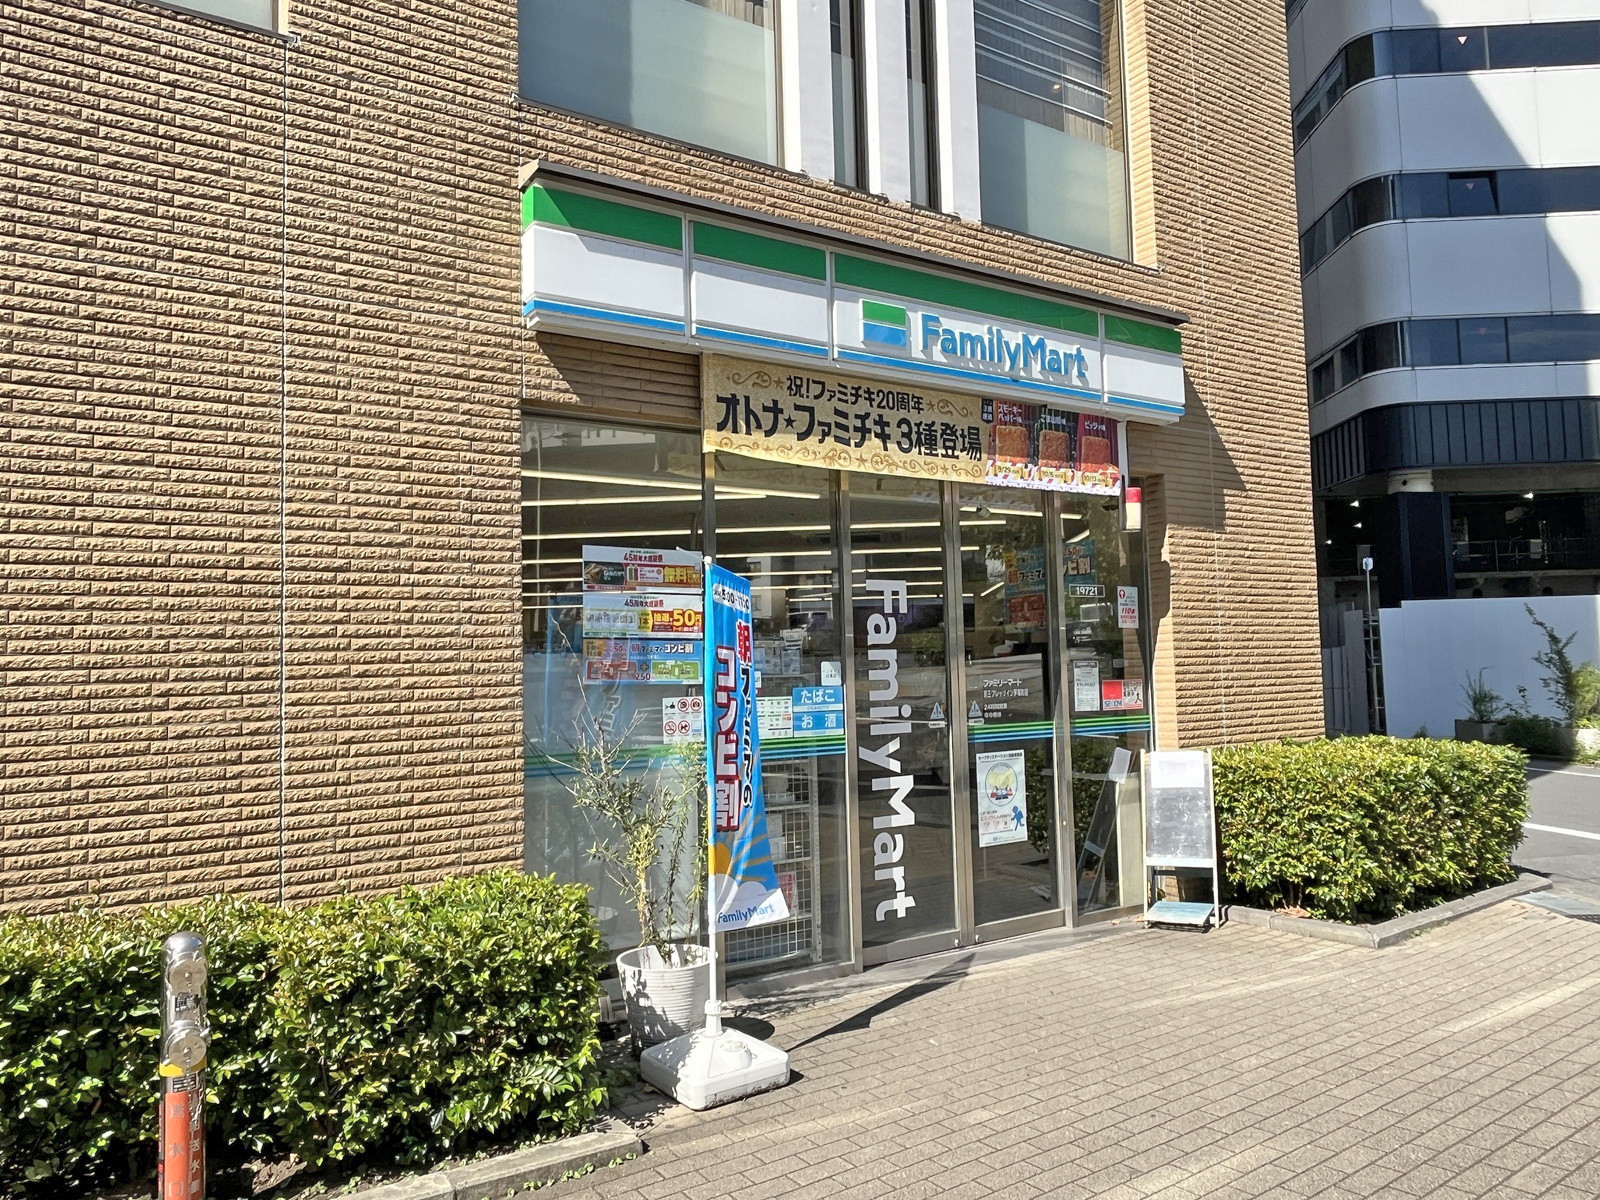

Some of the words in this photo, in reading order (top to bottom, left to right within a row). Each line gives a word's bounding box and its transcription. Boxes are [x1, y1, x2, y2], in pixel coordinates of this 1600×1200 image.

[919, 311, 1089, 378] FamilyMart
[787, 375, 925, 414] 祝!ファミチキ20周年
[1076, 586, 1098, 596] 19721
[801, 688, 835, 703] たばこ
[983, 678, 1022, 688] ファミリーマート
[716, 645, 741, 832] コンビ割
[859, 579, 916, 922] FamilyMart
[717, 903, 775, 923] FamilyMart
